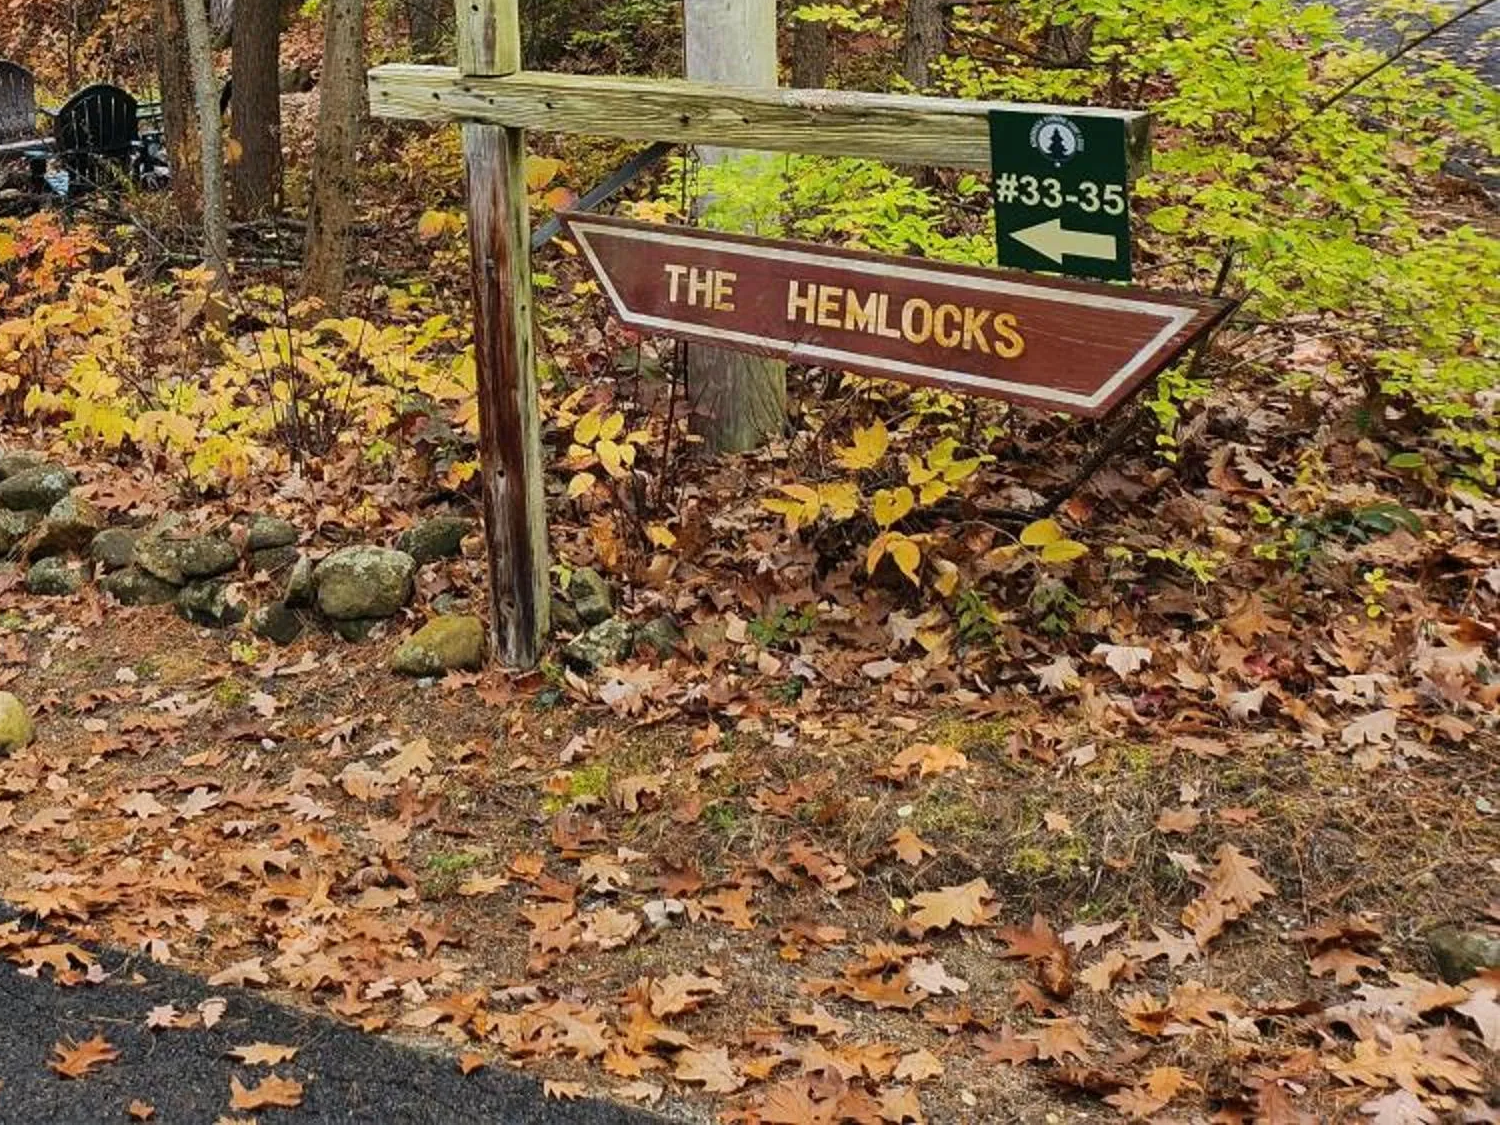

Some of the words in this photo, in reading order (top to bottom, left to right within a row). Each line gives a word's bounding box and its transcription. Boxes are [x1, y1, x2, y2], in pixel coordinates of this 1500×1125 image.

[996, 173, 1125, 215] #33-35
[664, 263, 737, 312] THE
[787, 280, 1026, 358] HEMLOCKS
